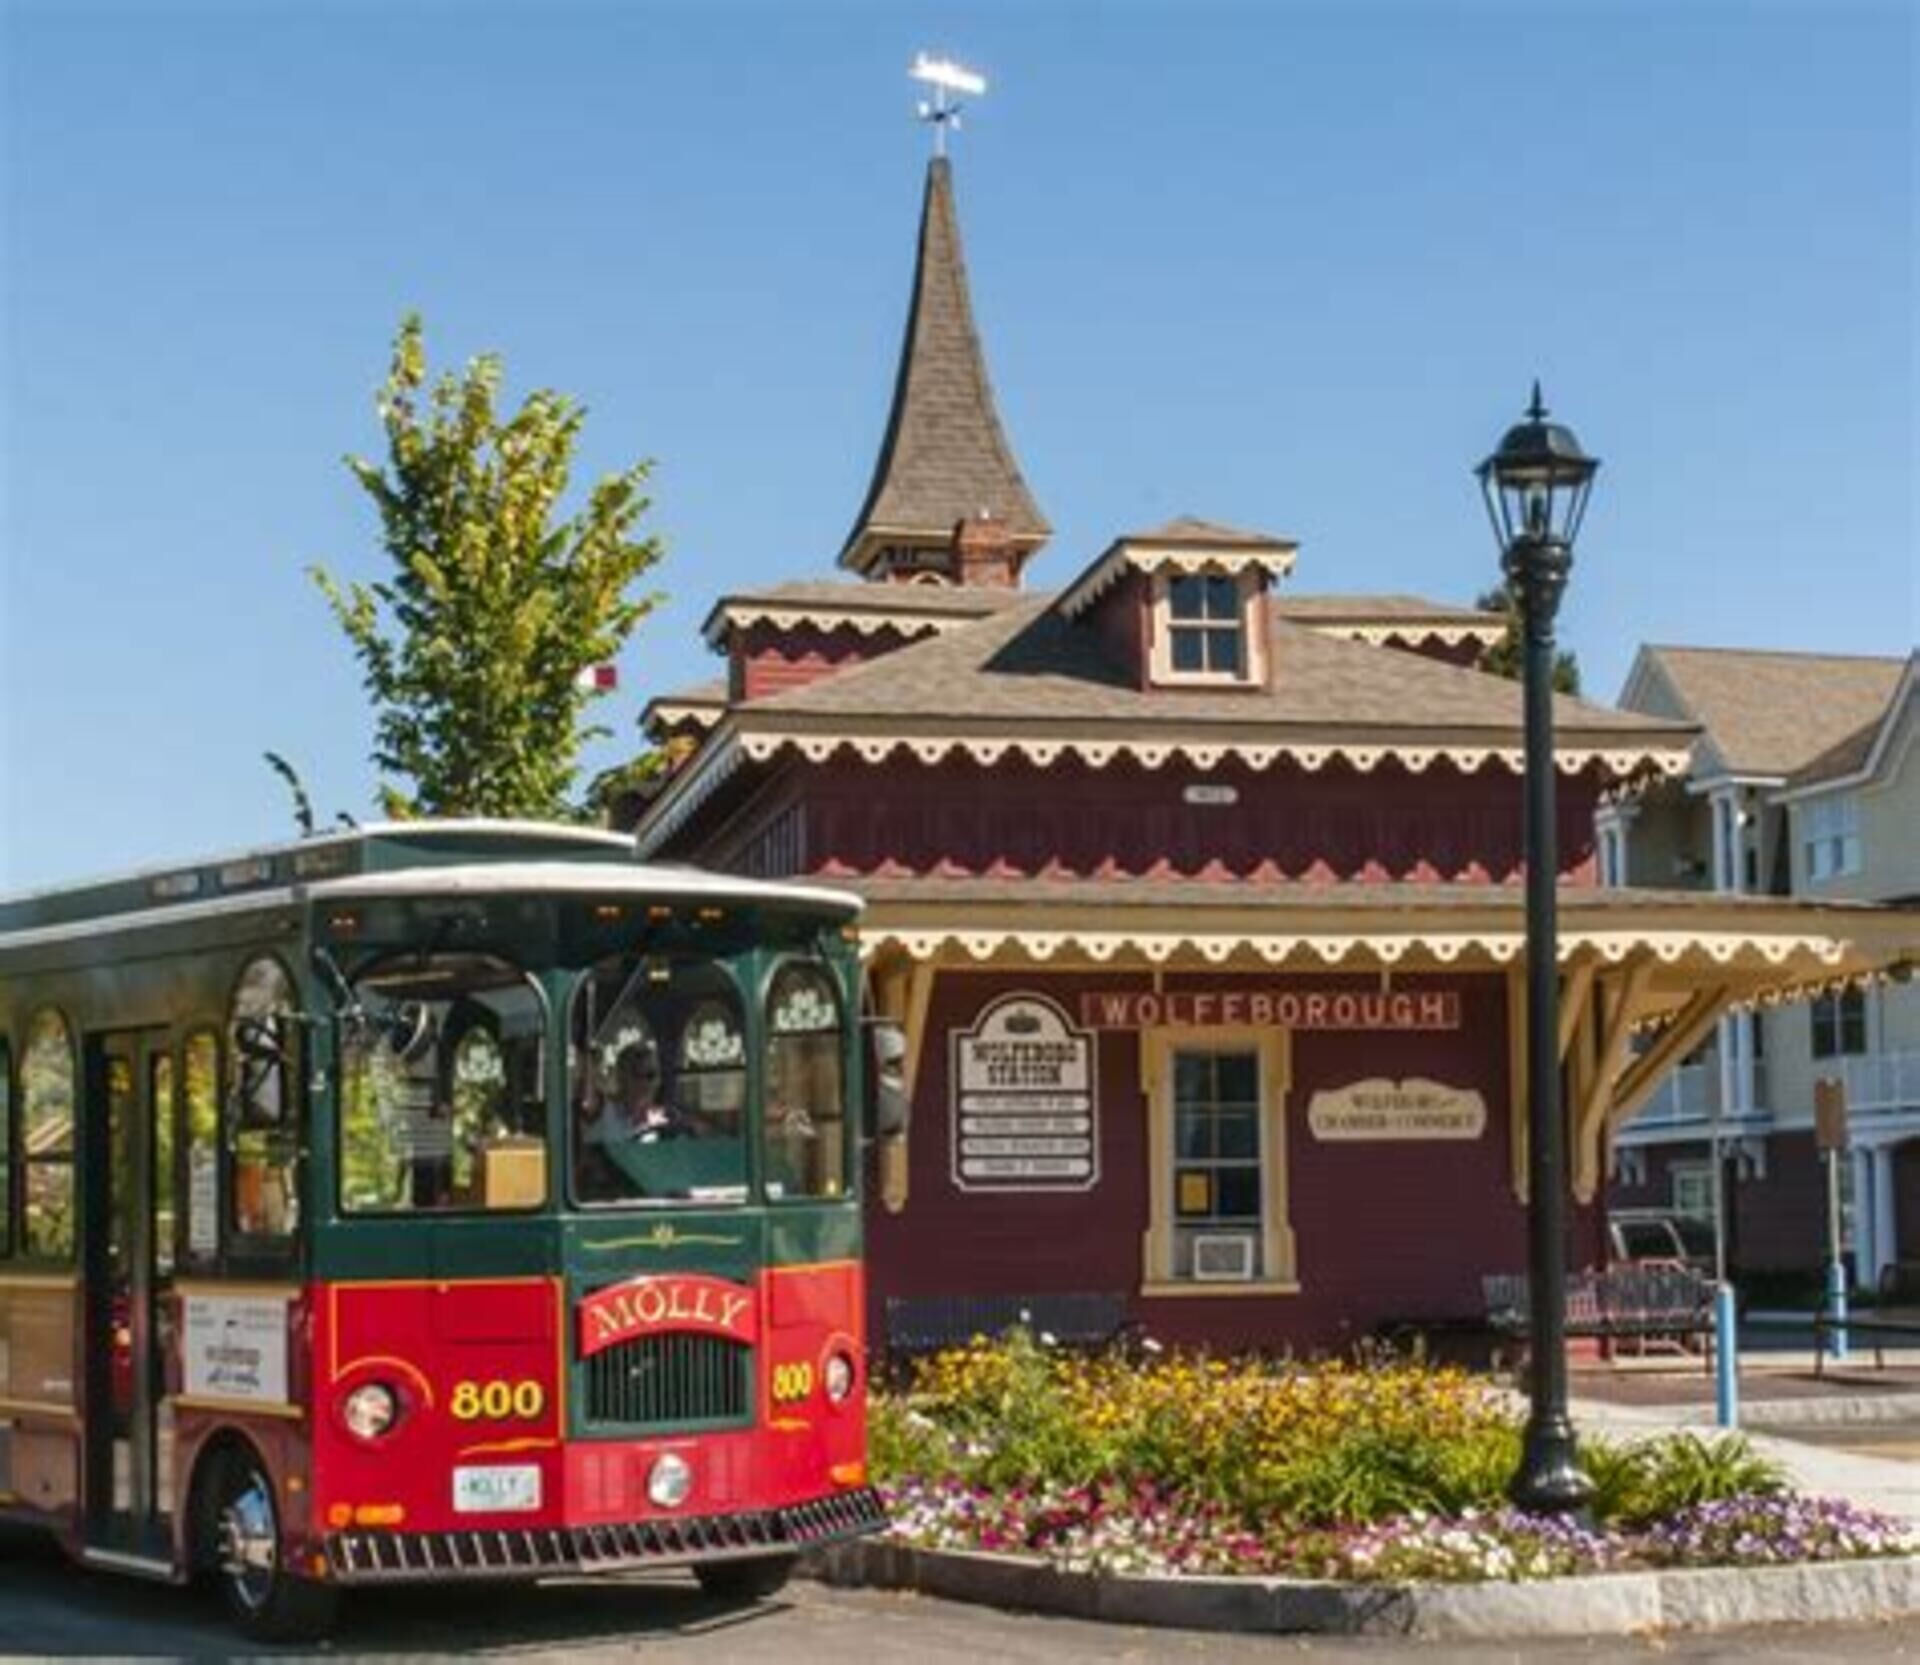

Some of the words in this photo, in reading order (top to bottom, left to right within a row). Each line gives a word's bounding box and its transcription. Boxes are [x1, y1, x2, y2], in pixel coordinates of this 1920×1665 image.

[1100, 993, 1447, 1026] WOLFEBOROUGH
[986, 1063, 1062, 1086] STATION
[590, 1282, 748, 1340] MOLLY
[450, 1380, 543, 1420] 800
[773, 1362, 812, 1400] 800
